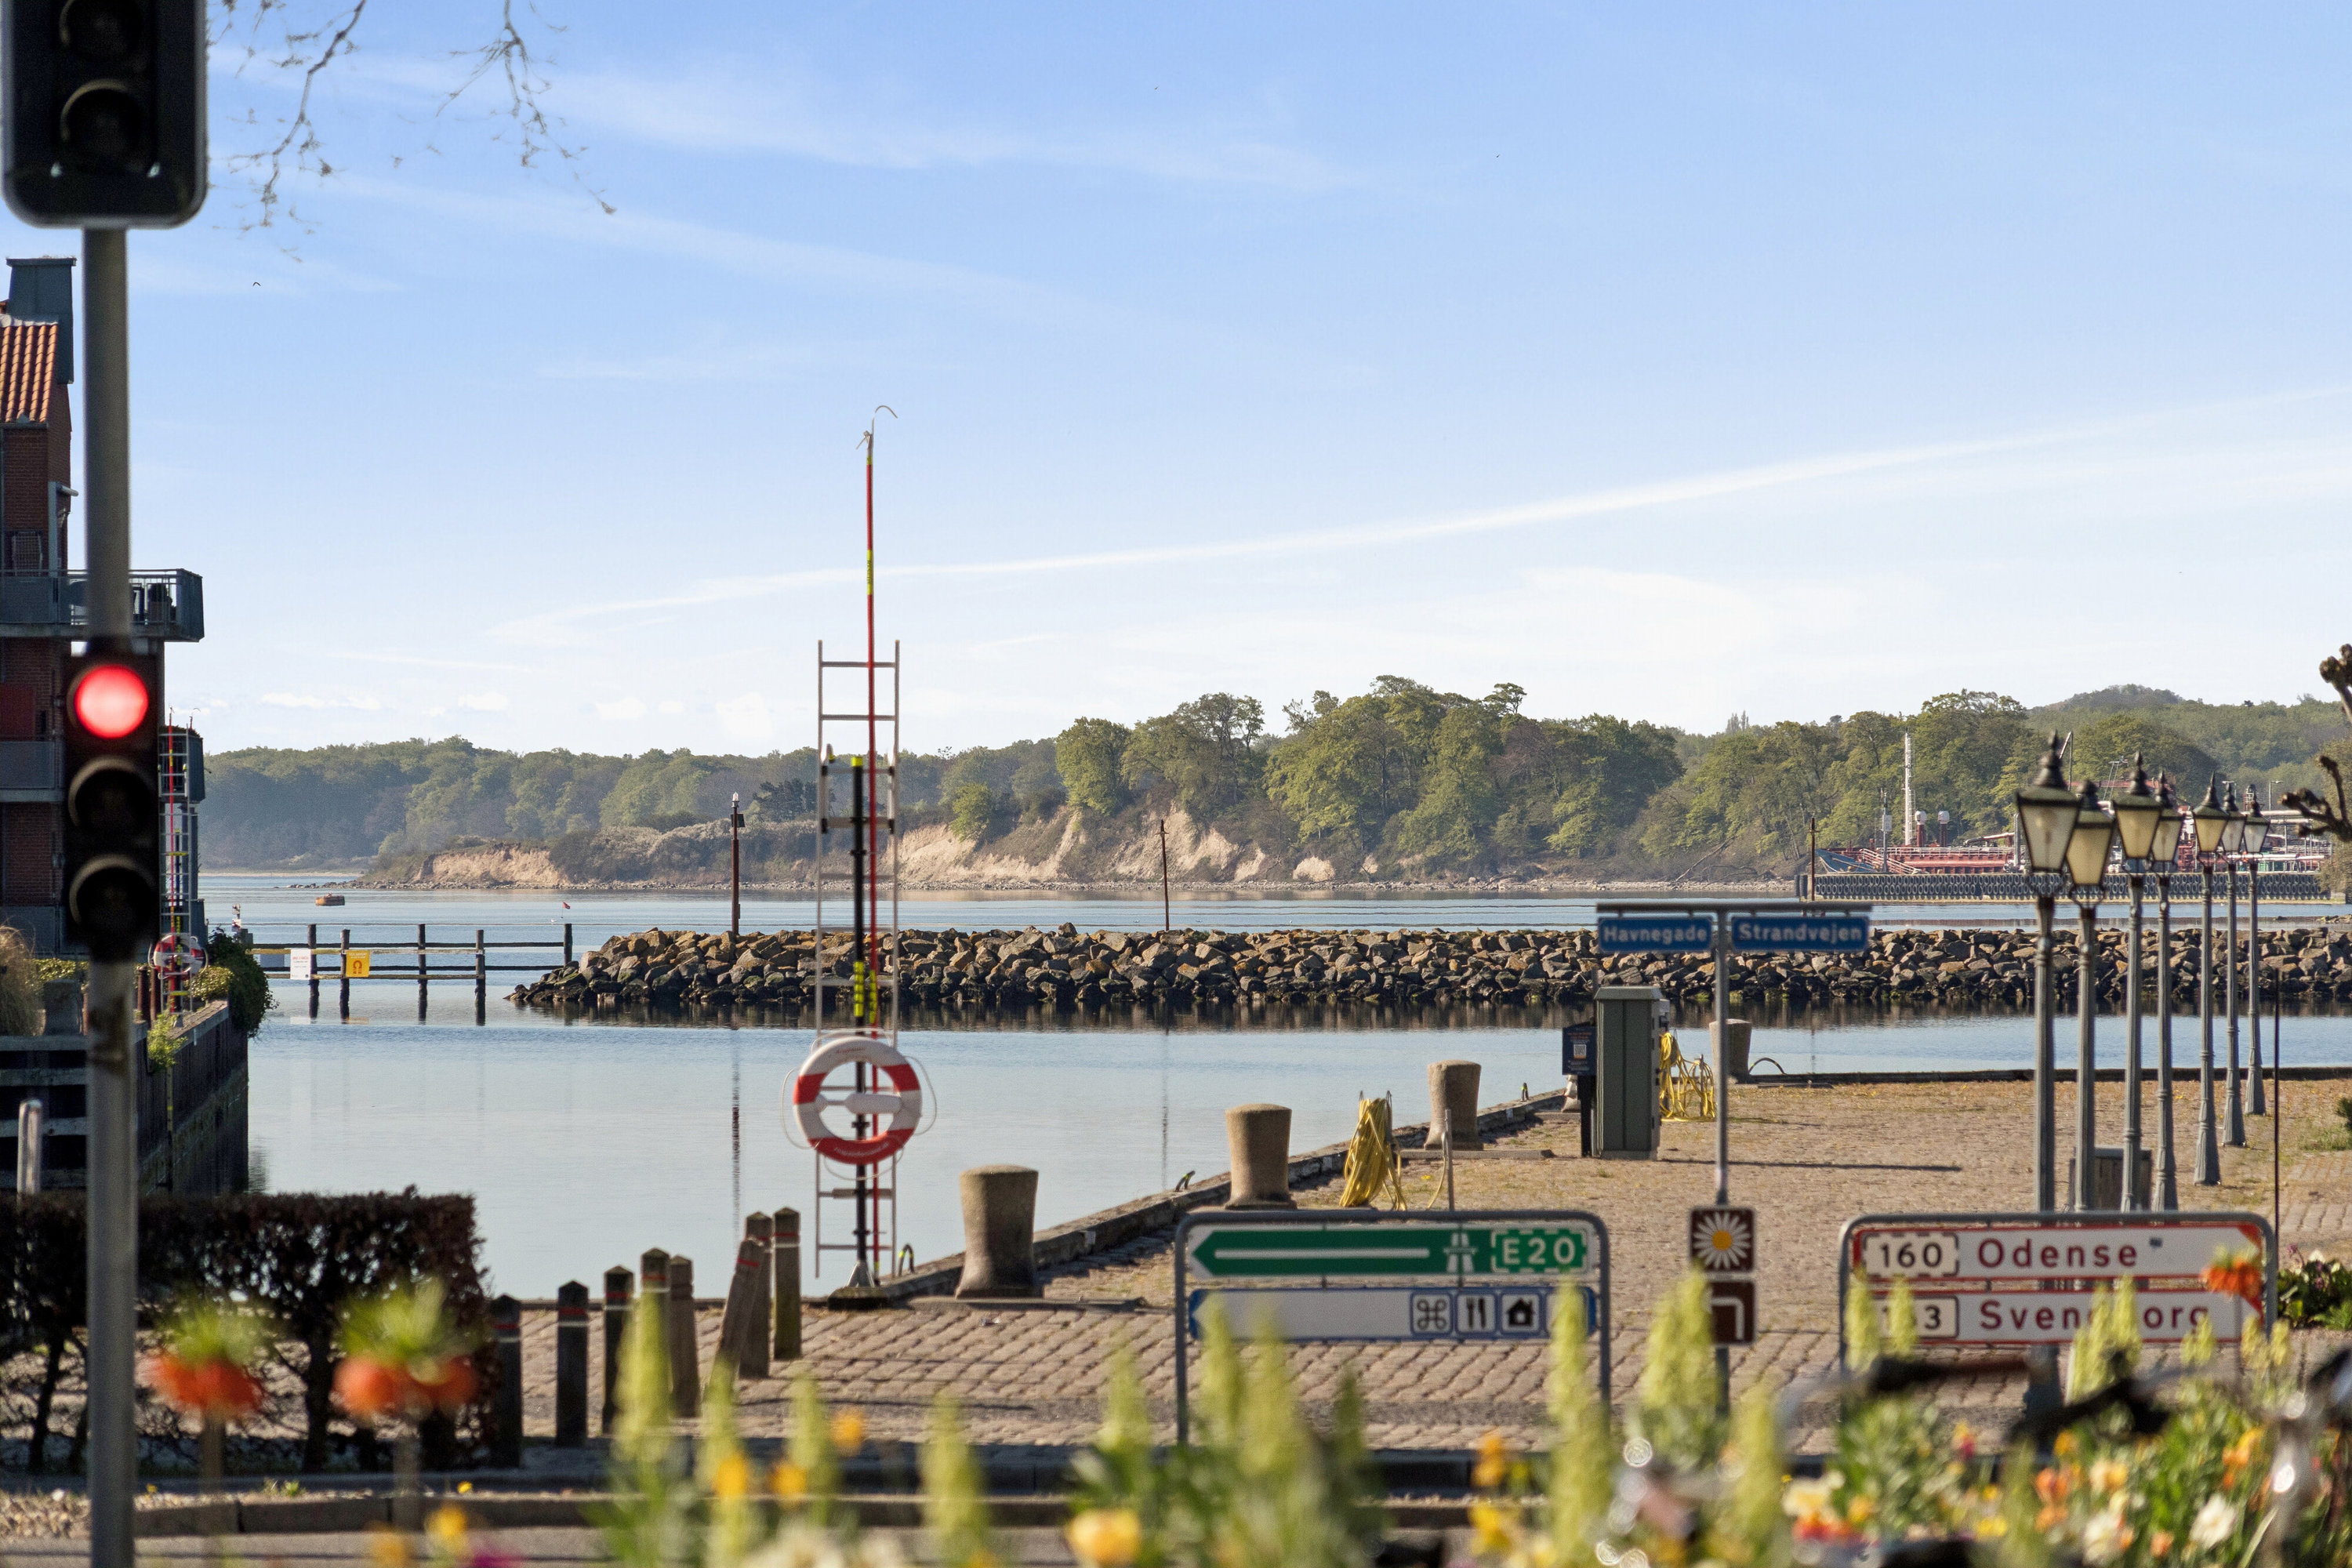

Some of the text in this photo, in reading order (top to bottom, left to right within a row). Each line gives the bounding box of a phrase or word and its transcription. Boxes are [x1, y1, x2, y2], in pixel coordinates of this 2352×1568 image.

[1603, 925, 1708, 946] Havnegade
[1738, 922, 1862, 944] Strandvejen
[1502, 1237, 1575, 1265] E20
[1882, 1237, 2137, 1269] 160 Odense
[1980, 1300, 2209, 1334] Svenor
